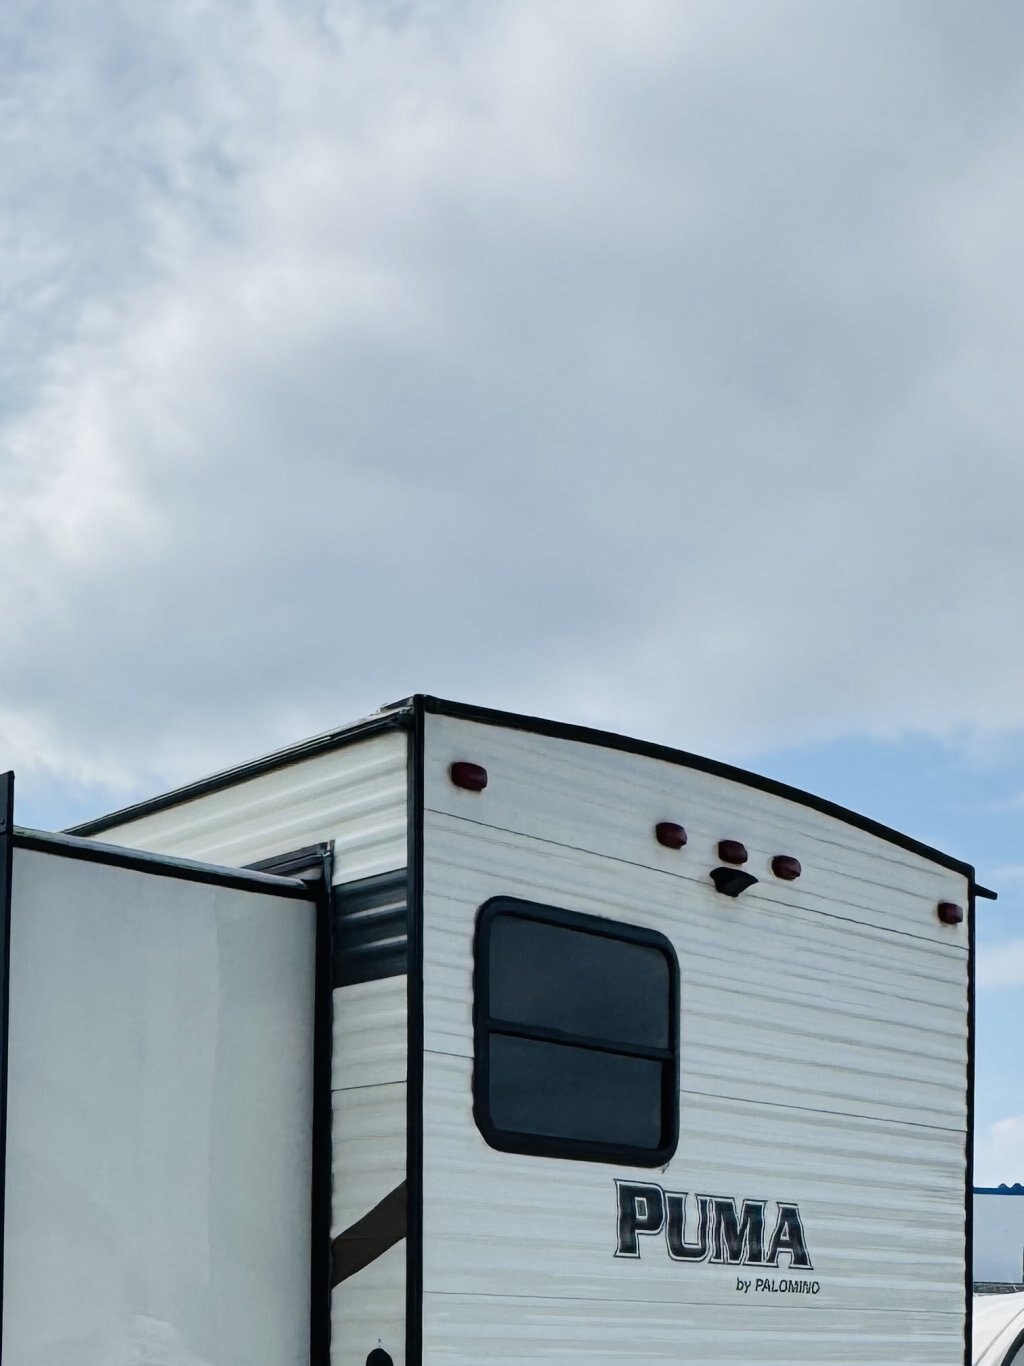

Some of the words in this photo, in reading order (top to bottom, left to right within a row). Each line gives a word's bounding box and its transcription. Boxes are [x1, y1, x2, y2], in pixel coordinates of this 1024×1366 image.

[613, 1178, 814, 1270] PUMA
[736, 1277, 751, 1294] by
[755, 1278, 820, 1295] PALOMINO
